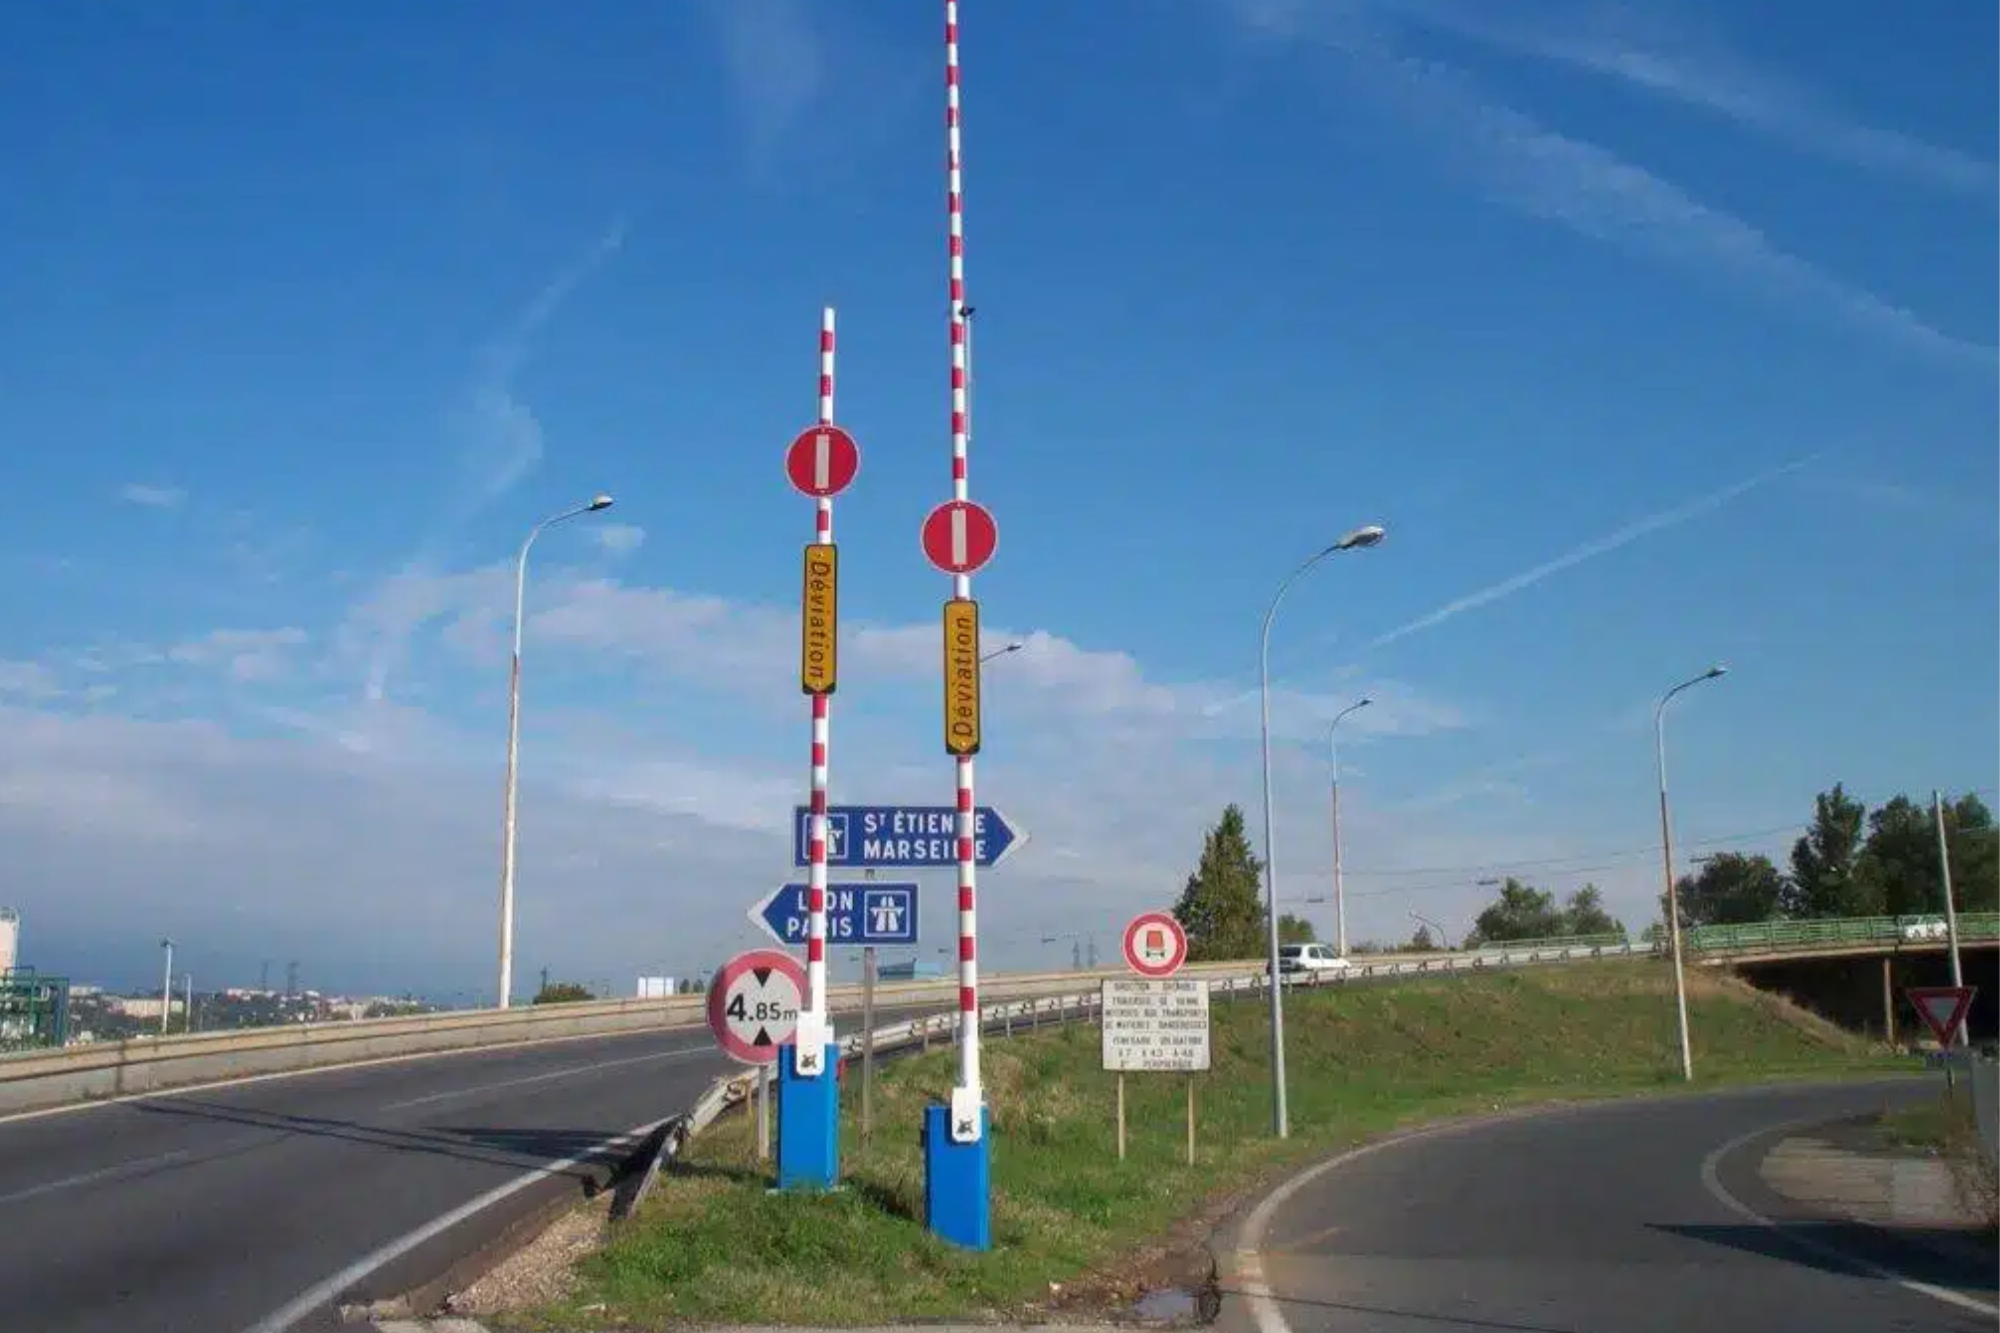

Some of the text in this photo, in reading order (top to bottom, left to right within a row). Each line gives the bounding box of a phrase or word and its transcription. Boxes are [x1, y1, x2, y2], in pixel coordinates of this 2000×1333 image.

[810, 562, 831, 679] Déviation
[894, 810, 986, 834] ÉTIENE
[863, 839, 986, 860] MARSEIE
[798, 890, 853, 911] LON
[787, 916, 852, 938] PAIS
